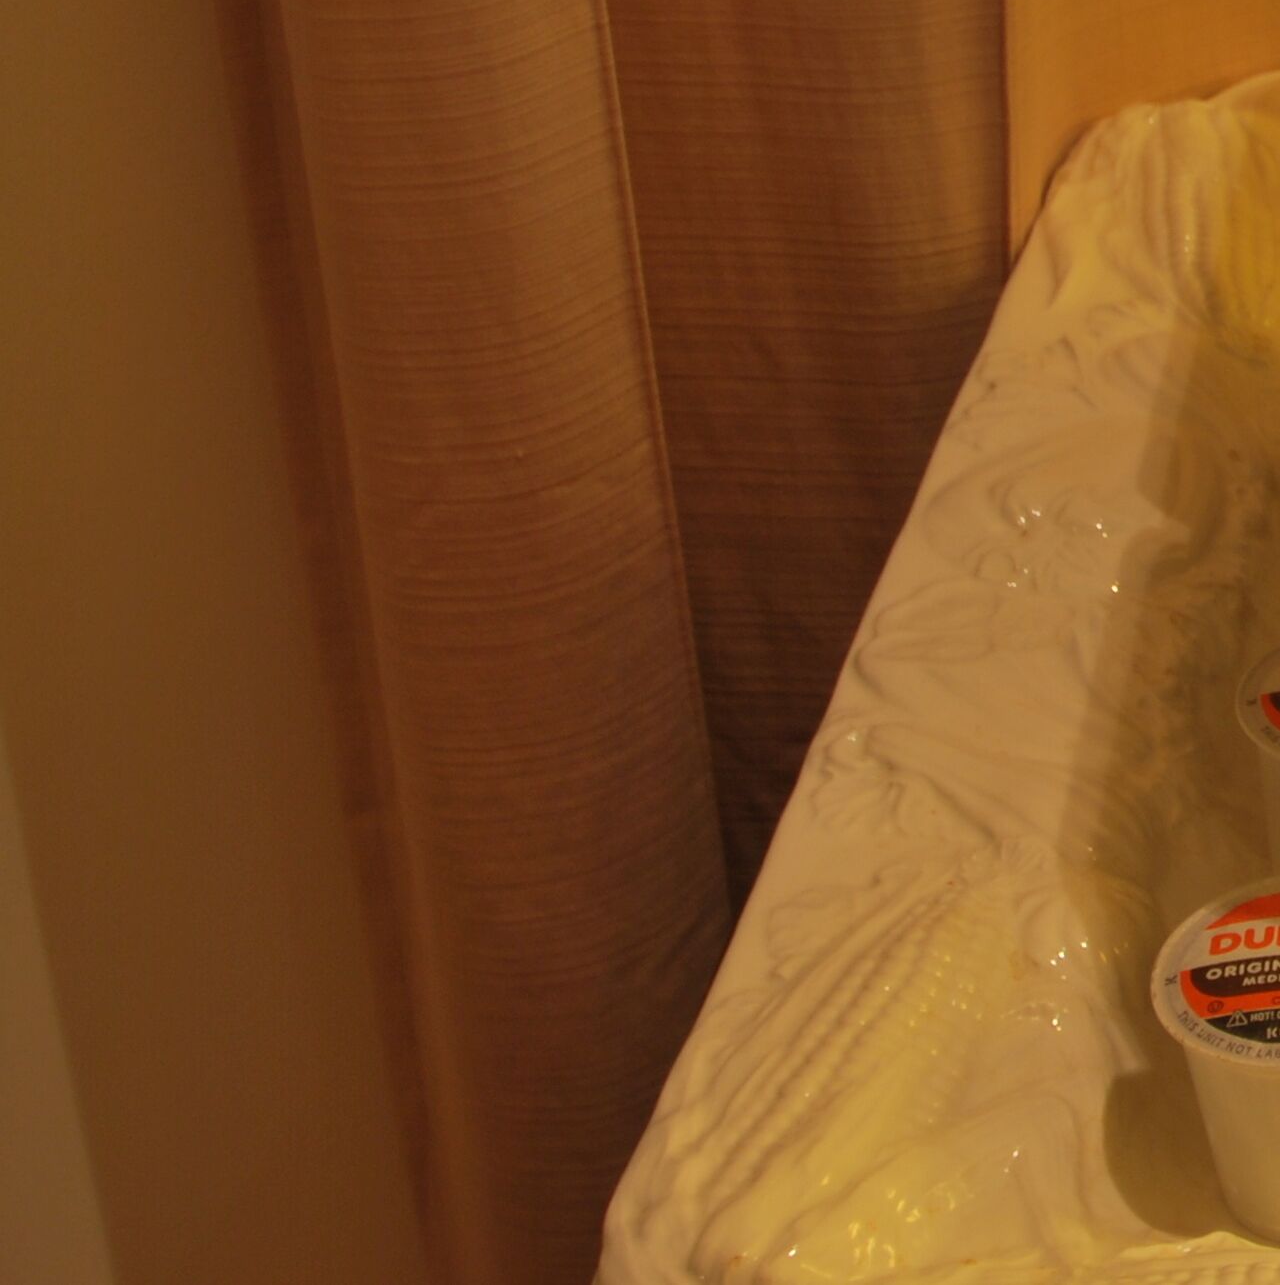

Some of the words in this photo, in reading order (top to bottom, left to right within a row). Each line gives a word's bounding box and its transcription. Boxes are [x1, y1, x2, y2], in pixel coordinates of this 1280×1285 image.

[1250, 1010, 1275, 1021] HOT!
[1177, 1010, 1200, 1033] THIS
[1198, 1026, 1224, 1047] UNIT
[1225, 1039, 1251, 1058] NOT
